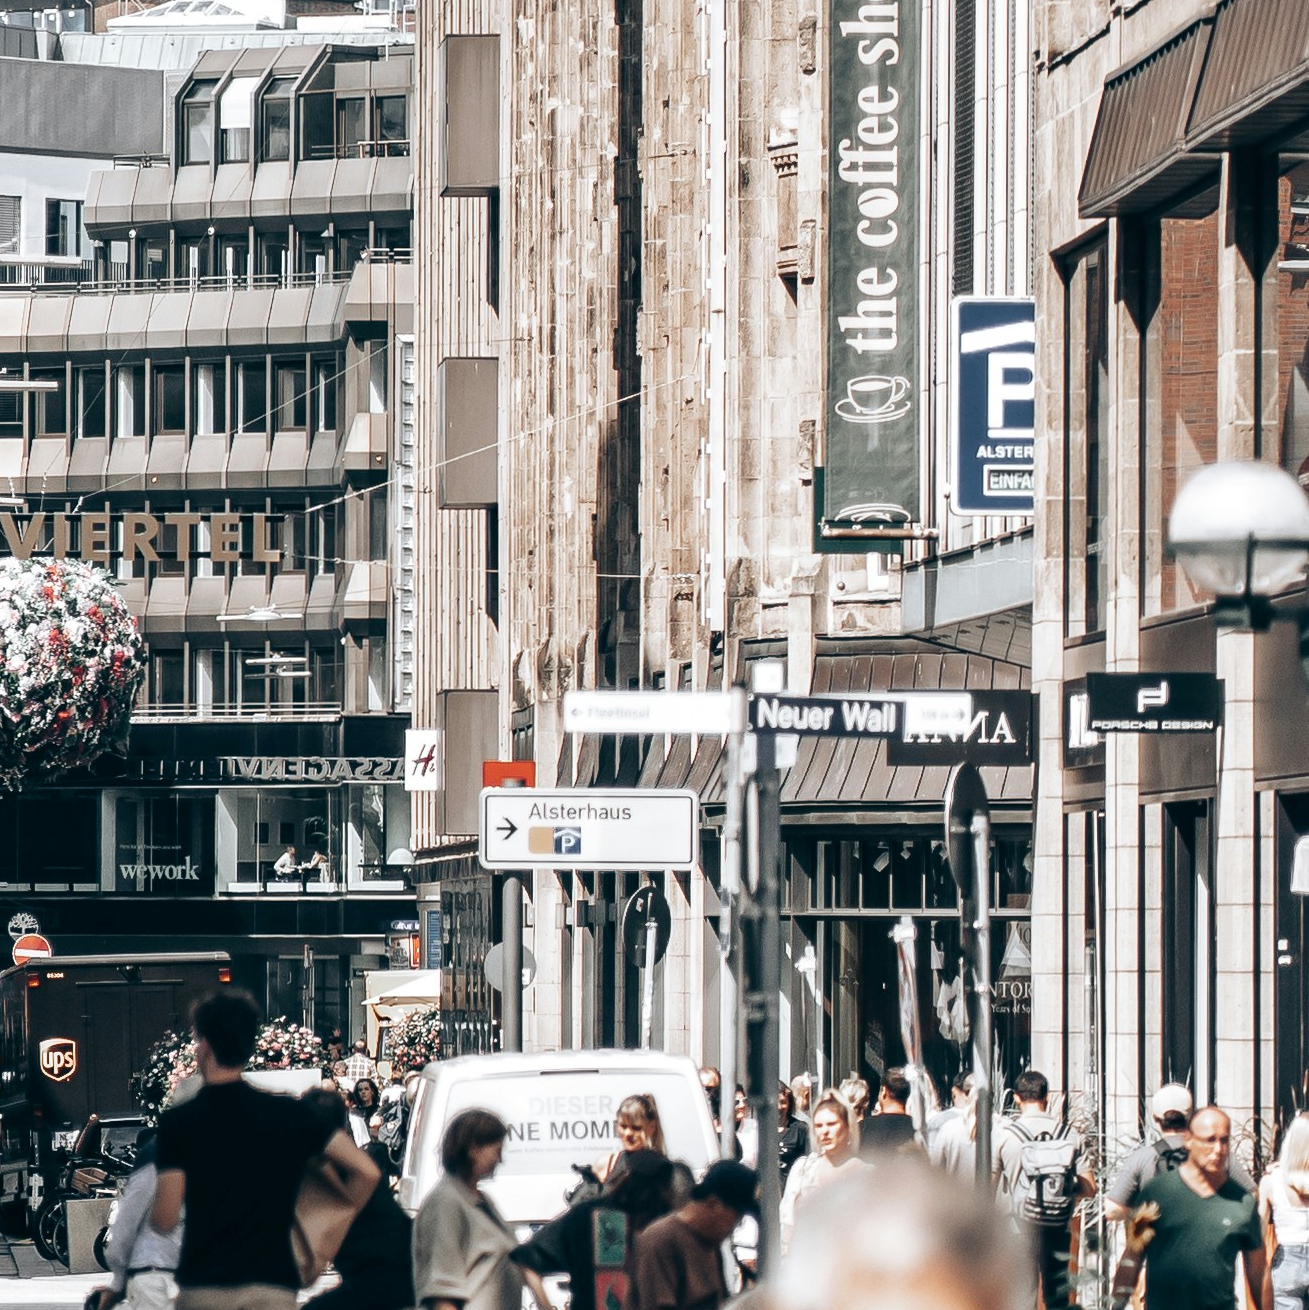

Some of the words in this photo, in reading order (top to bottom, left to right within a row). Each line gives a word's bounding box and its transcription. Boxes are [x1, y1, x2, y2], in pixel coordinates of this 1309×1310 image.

[837, 84, 900, 248] coffee
[837, 266, 900, 355] the
[756, 698, 834, 731] Neuer
[841, 701, 897, 733] Wall
[1092, 720, 1158, 730] PORSCHE
[1161, 720, 1214, 730] DESIGN
[528, 802, 632, 821] Alsterhaus
[119, 855, 200, 881] wework
[43, 1050, 74, 1074] ups
[530, 1094, 614, 1117] DIESER
